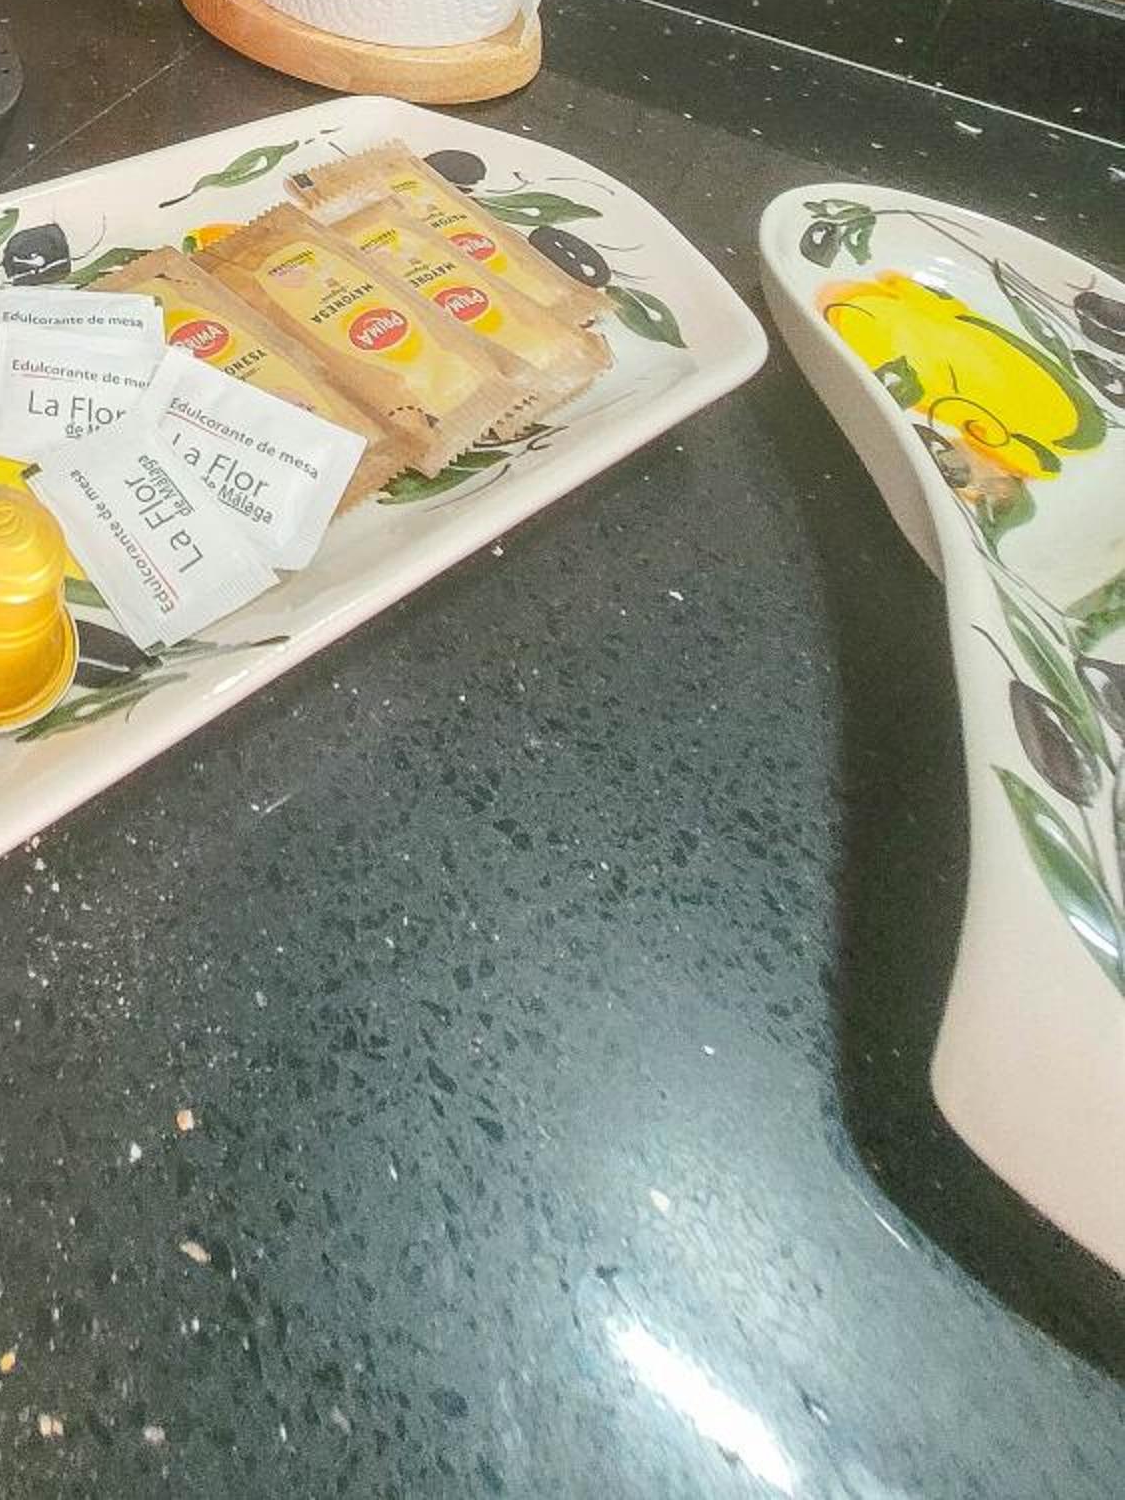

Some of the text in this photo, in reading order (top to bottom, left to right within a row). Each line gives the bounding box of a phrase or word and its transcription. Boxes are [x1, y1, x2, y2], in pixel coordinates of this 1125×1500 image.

[410, 261, 457, 288] MAYONE
[2, 311, 144, 328] Edulcorante de mesa
[309, 282, 374, 324] MAYONESA
[356, 311, 404, 345] PRIMA
[12, 359, 151, 388] Edulcorante de me
[224, 347, 268, 376] ONESA
[28, 390, 126, 425] La Flor
[65, 423, 83, 435] de
[170, 397, 318, 479] Edulcorante de mesa
[70, 469, 100, 501] mesa
[138, 455, 192, 517] de Málaga
[208, 453, 270, 498] Flor
[96, 502, 112, 521] de
[218, 483, 274, 524] Málaga
[124, 477, 204, 573] La Flor
[110, 520, 175, 614] Edulcorante
